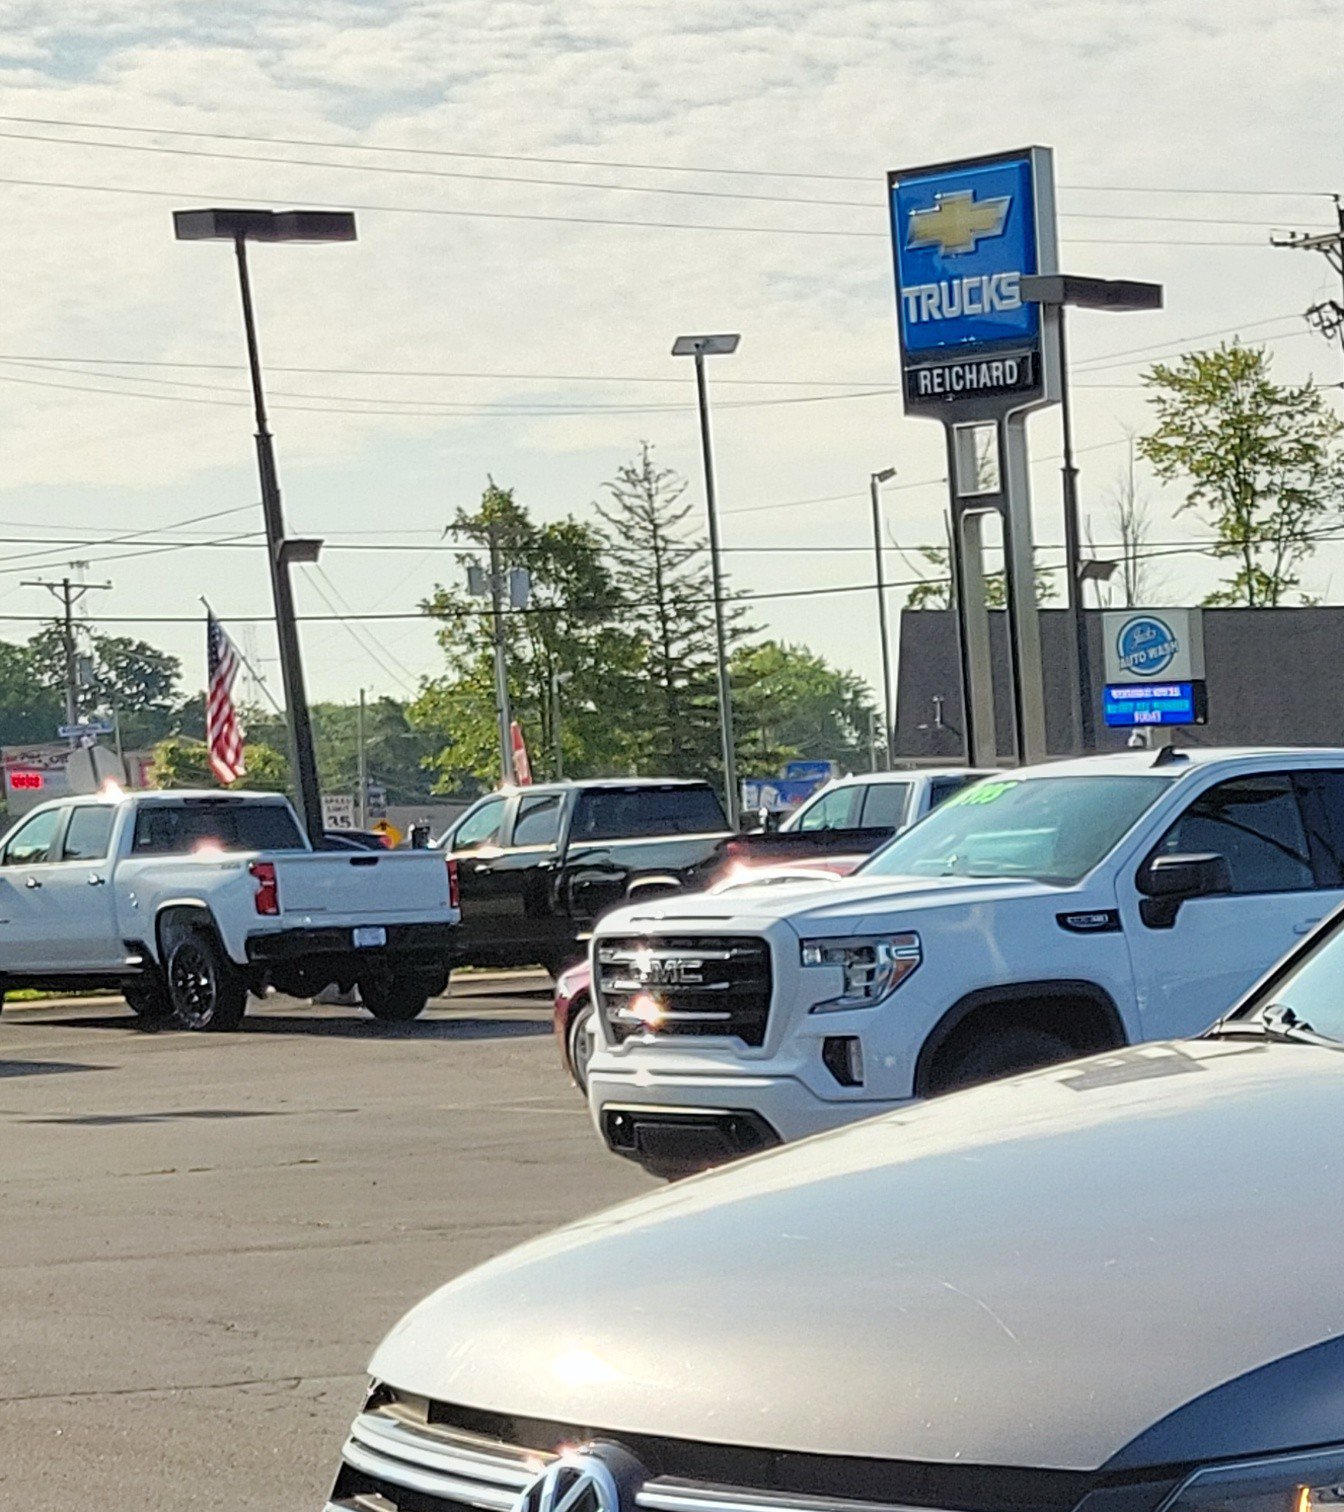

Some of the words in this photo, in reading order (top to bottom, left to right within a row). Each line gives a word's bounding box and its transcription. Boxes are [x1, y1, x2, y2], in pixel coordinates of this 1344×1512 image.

[902, 271, 1022, 324] TRUCKS
[919, 359, 1019, 395] REICHARD
[1120, 652, 1147, 669] AUTO
[1148, 640, 1179, 660] WASH
